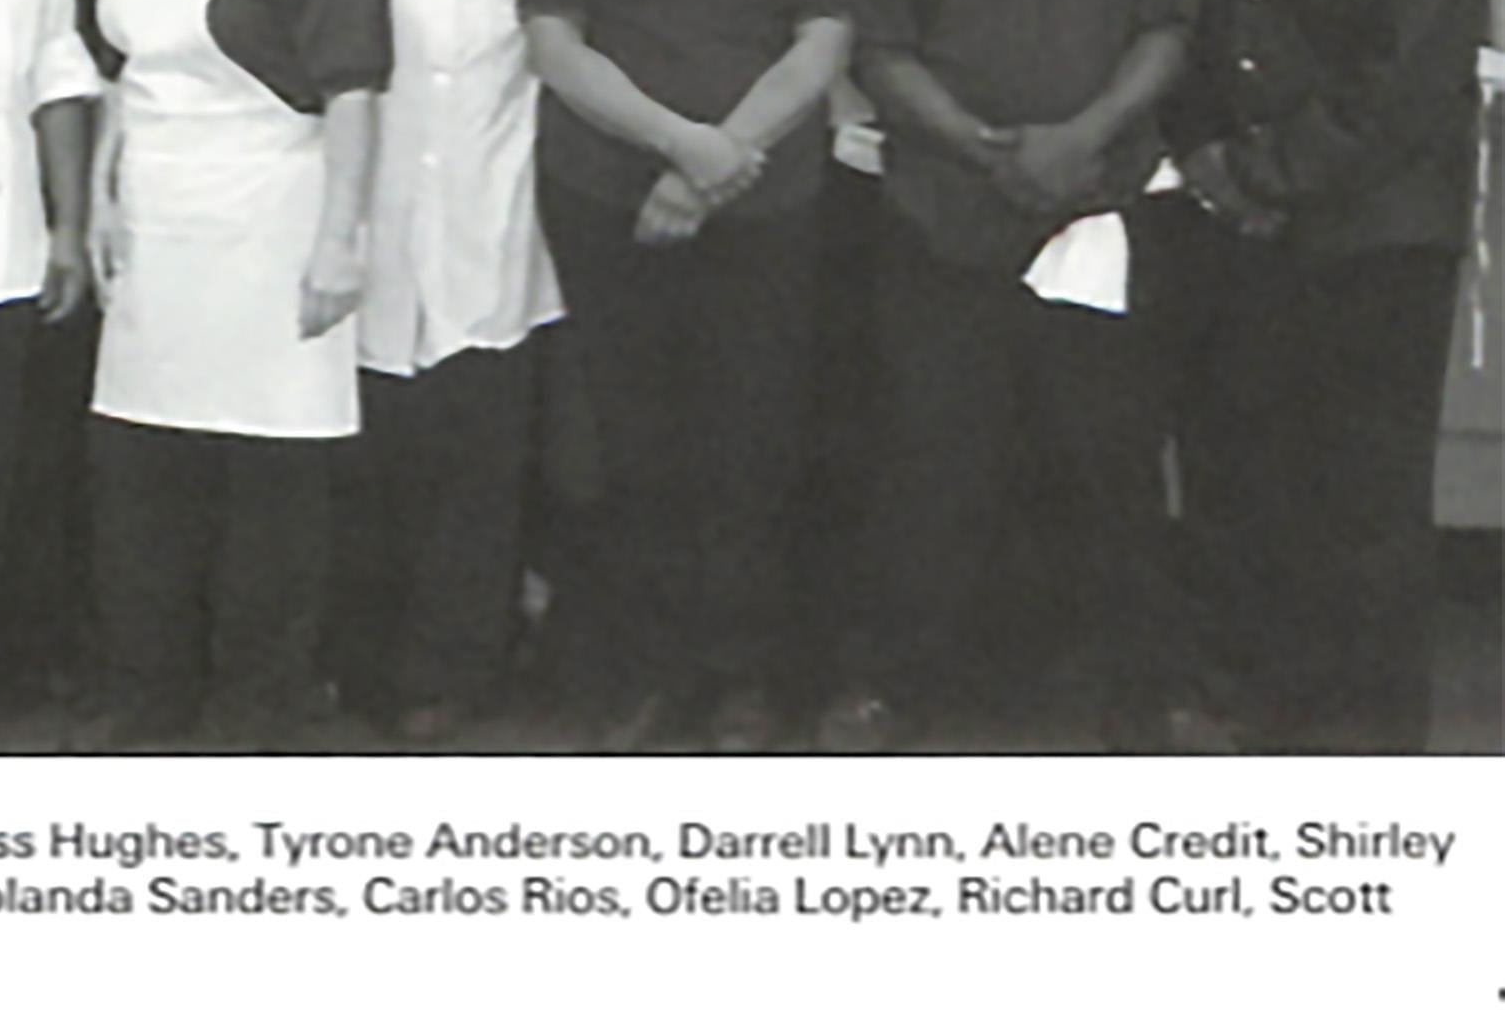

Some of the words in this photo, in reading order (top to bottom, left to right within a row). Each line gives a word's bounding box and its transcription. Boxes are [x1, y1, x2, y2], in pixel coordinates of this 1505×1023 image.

[49, 822, 240, 870] Hughes,
[253, 821, 414, 867] Tyrone
[425, 822, 663, 863] Anderson,
[678, 822, 831, 860] Darrell
[845, 822, 966, 867] Lynn,
[979, 822, 1116, 860] Alene
[1129, 821, 1281, 861] Credit,
[1296, 821, 1456, 866] Shirley
[147, 876, 348, 918] Sanders,
[362, 875, 509, 915] Carlos
[521, 876, 631, 918] Rios,
[645, 876, 780, 916] Ofelia
[794, 876, 942, 923] Lopez,
[958, 876, 1134, 915] Richard
[1149, 875, 1254, 917] Curl,
[1270, 875, 1392, 915] Scott
